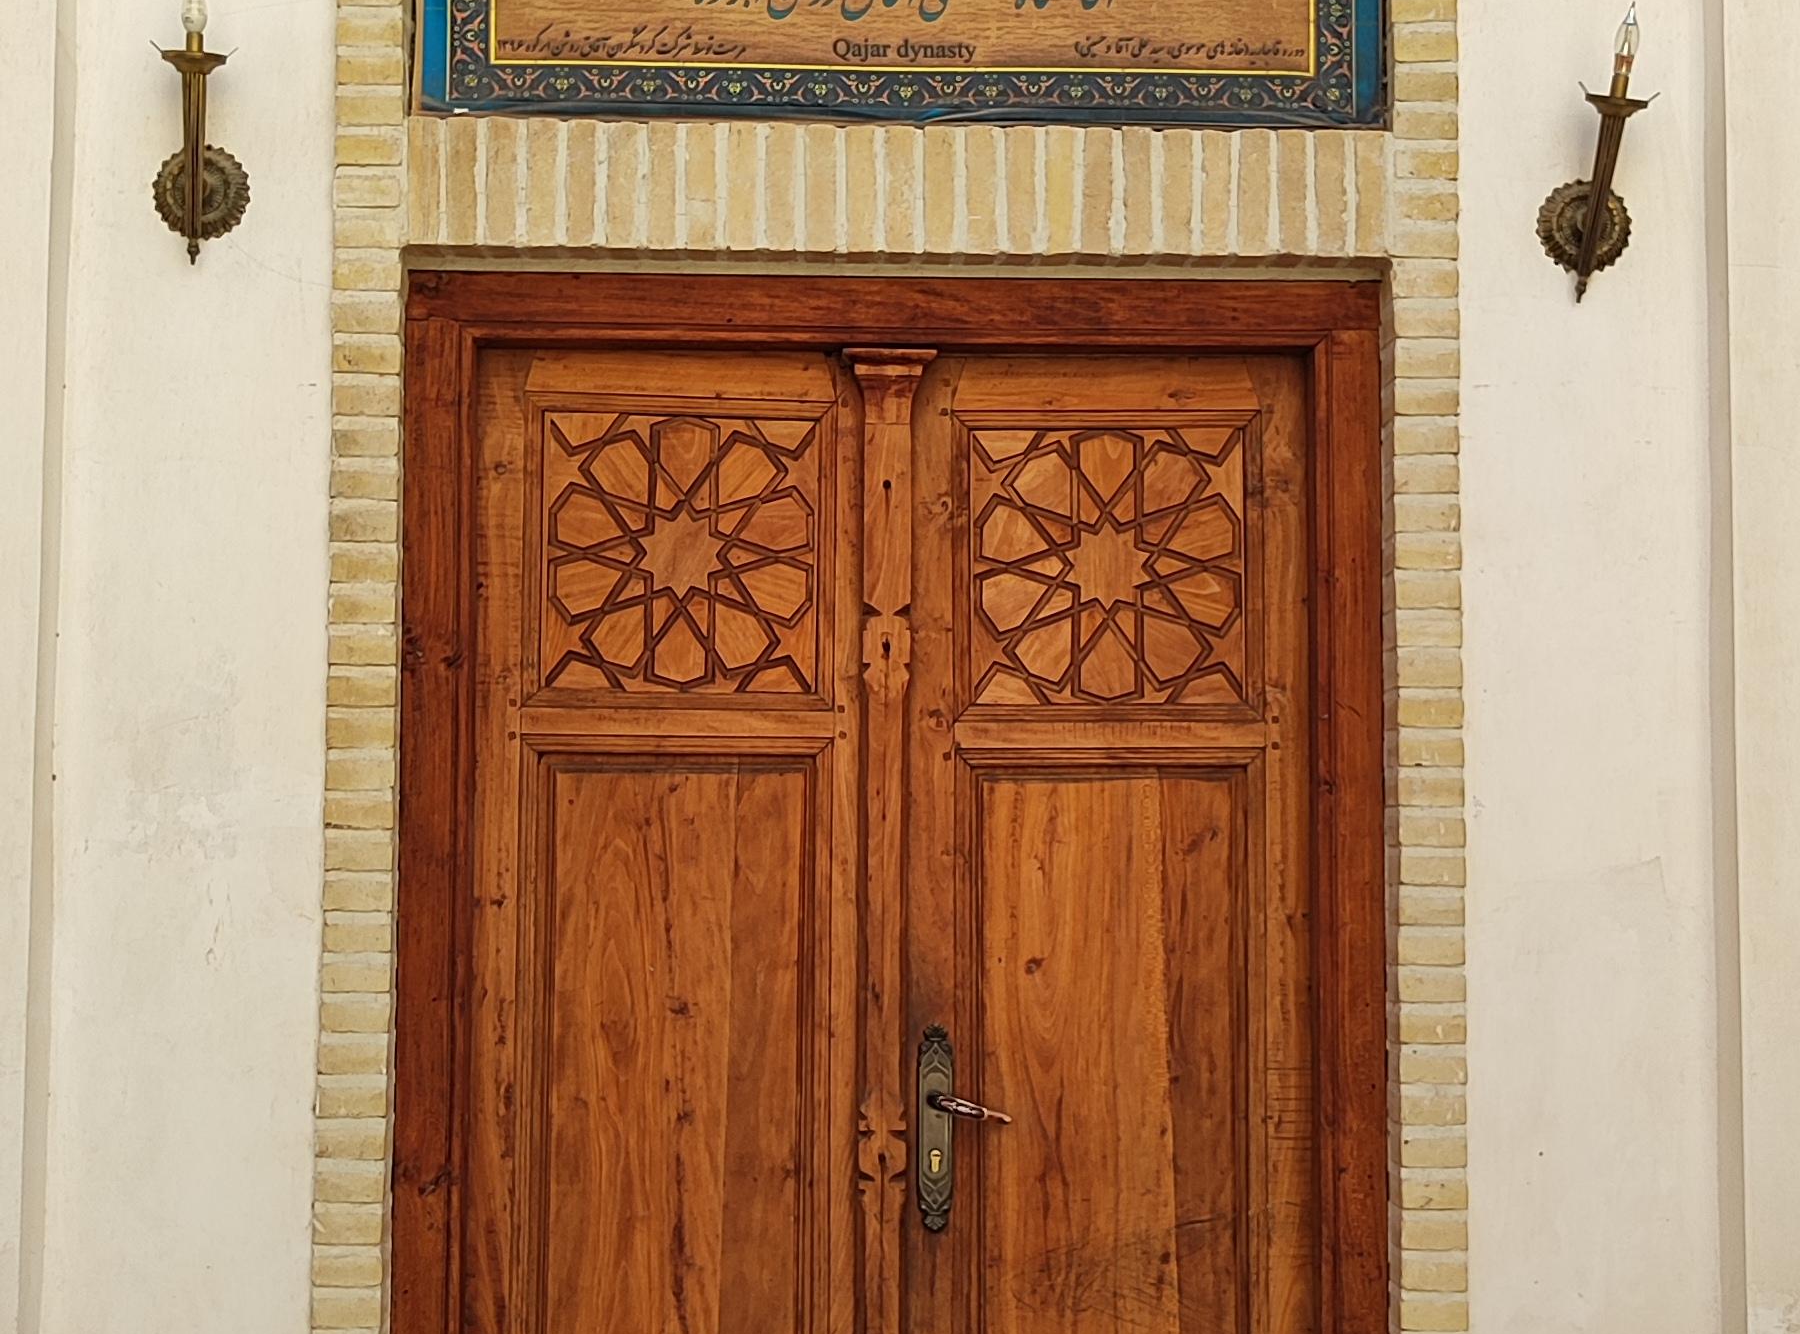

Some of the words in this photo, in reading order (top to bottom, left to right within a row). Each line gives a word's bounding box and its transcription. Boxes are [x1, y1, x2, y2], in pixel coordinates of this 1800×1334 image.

[655, 24, 693, 58] شرکت
[832, 37, 891, 63] Qajar
[896, 38, 977, 64] dynasty
